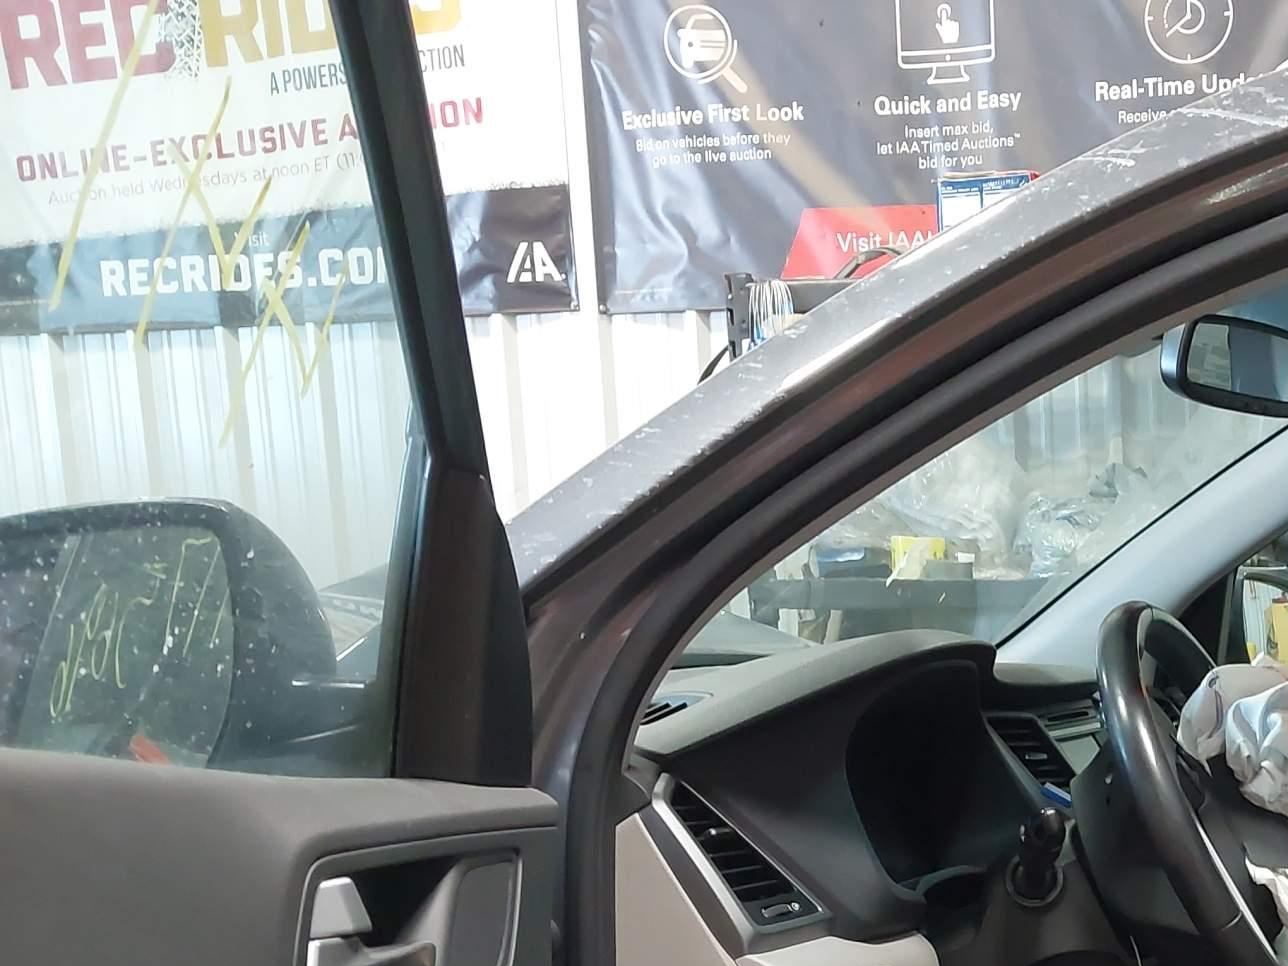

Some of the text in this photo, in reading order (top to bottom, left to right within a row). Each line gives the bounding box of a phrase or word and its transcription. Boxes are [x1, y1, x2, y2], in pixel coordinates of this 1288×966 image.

[0, 0, 176, 90] REC
[270, 71, 280, 96] A
[416, 44, 466, 73] CTION
[1095, 76, 1196, 101] Real-Time
[874, 89, 1021, 116] Quick and Easy
[622, 101, 805, 130] Exclusive First Look
[904, 120, 994, 138] Insert max bid,
[636, 132, 791, 152] Bid on vehicles before they
[876, 142, 893, 155] let
[652, 148, 772, 168] go to the live auction
[918, 154, 982, 169] bid for you
[48, 178, 107, 208] Aucon
[111, 177, 144, 199] held
[150, 168, 248, 192] Wedsdays
[252, 167, 268, 182] at
[271, 160, 310, 177] noon
[314, 155, 331, 172] ET
[836, 231, 882, 251] Visit
